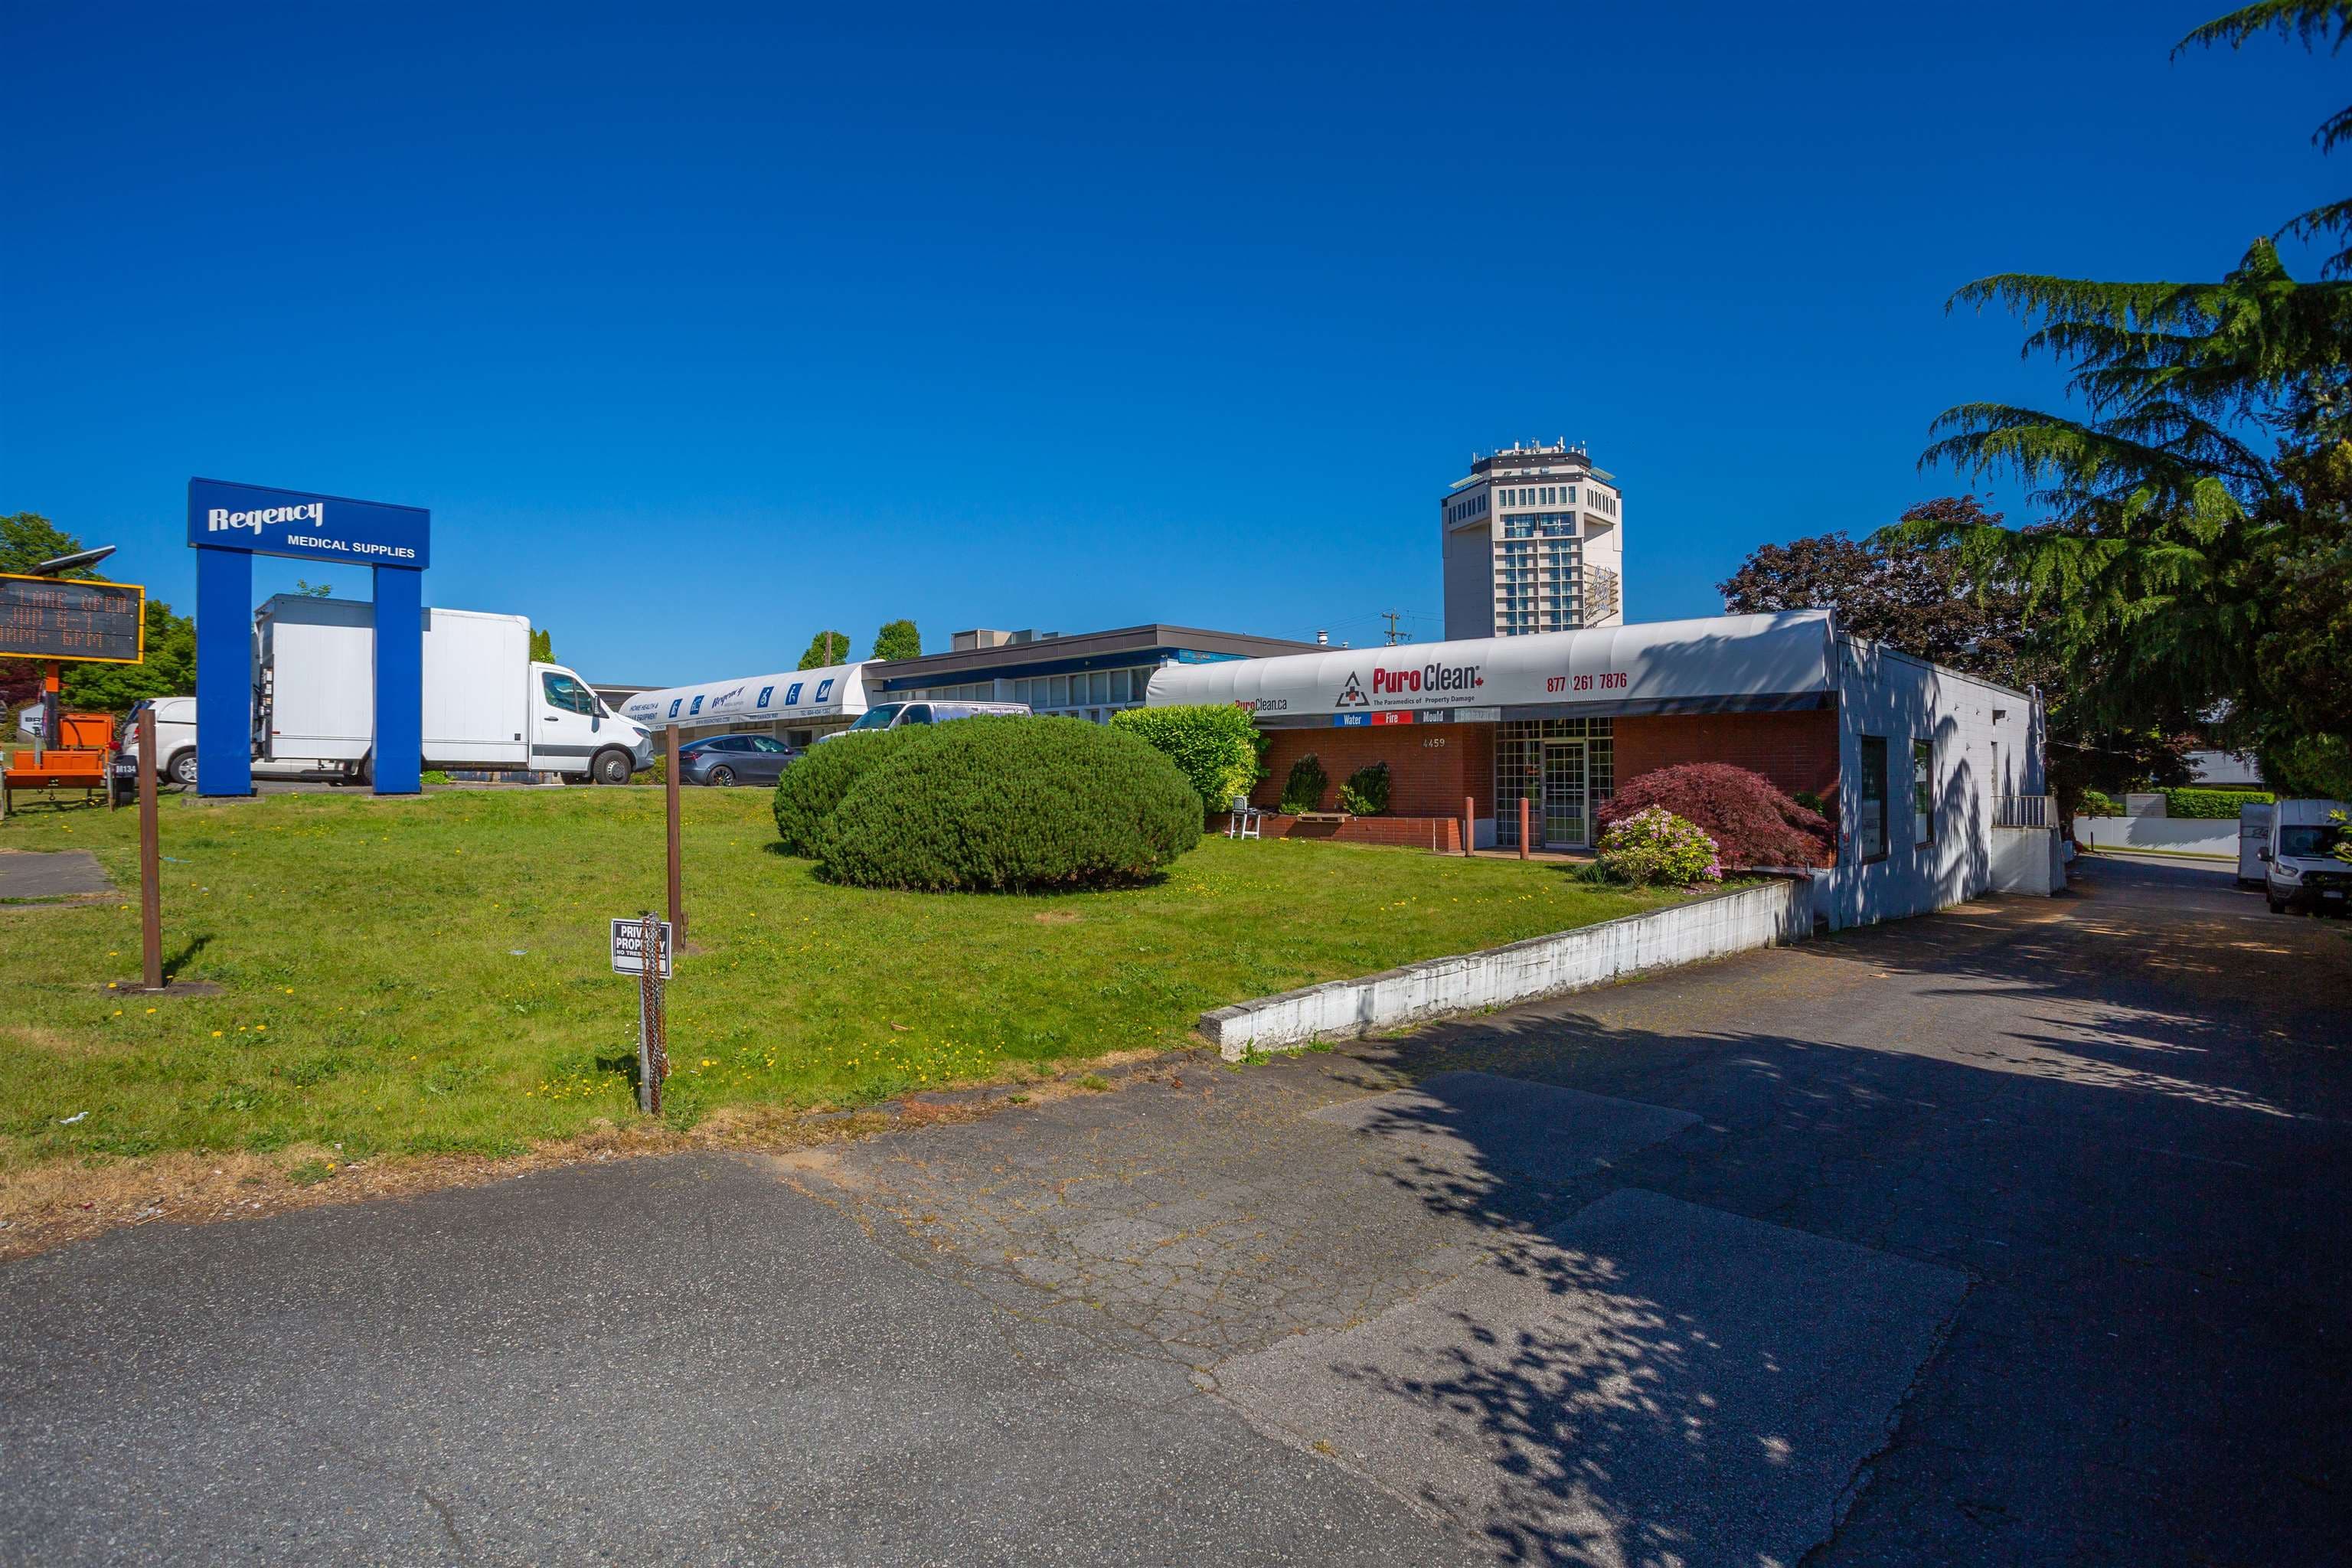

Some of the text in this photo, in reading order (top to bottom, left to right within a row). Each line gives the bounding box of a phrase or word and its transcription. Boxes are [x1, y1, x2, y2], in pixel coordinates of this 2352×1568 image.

[208, 502, 324, 535] Regency
[287, 534, 416, 559] MEDICAL SUPPLIES
[1547, 672, 1627, 693] 877 261 7876
[1425, 696, 1449, 704] Property
[1451, 695, 1475, 704] Damage
[1344, 714, 1362, 726] Water
[1386, 712, 1399, 724] Fire
[1423, 710, 1444, 724] Mould
[1423, 738, 1446, 748] 4459
